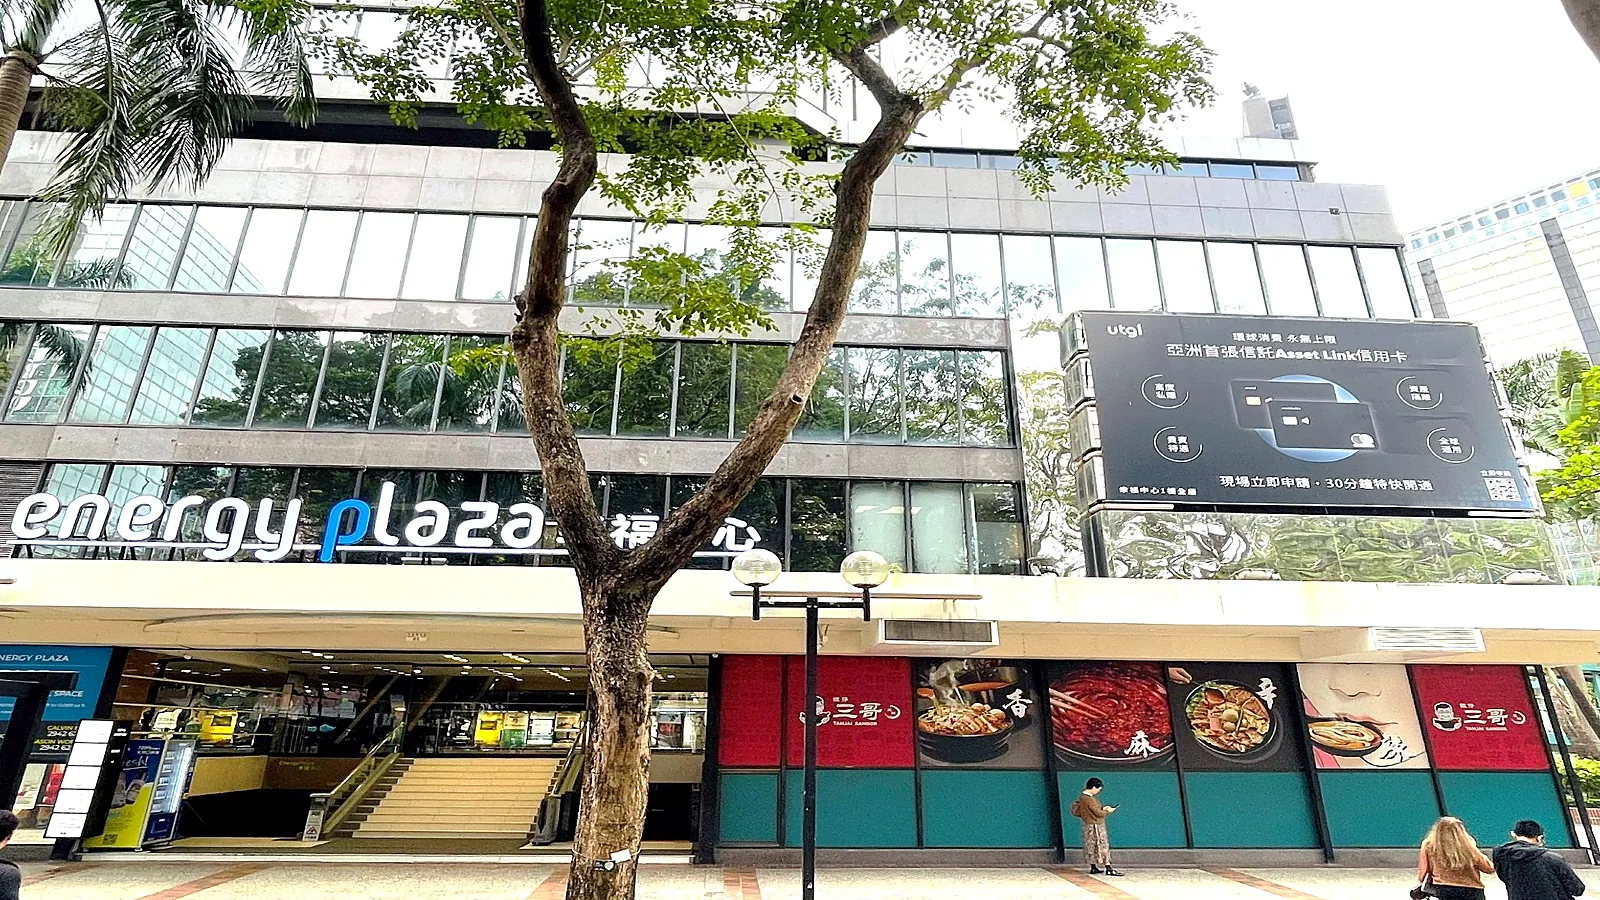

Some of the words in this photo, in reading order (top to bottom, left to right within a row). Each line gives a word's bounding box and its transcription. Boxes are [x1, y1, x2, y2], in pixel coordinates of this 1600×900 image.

[1232, 332, 1282, 343] 環球消費
[1287, 334, 1337, 344] 永無上限
[1166, 344, 1320, 360] 亞洲首張信託Asset
[1323, 348, 1408, 364] Link信用卡
[1439, 437, 1460, 445] 全球
[10, 493, 302, 561] energy
[319, 481, 545, 563] plaza
[54, 690, 84, 698] SPACE
[1002, 688, 1033, 719] 香
[832, 702, 882, 721] 三哥
[1463, 708, 1509, 726] 三哥
[1123, 730, 1161, 759] 麻
